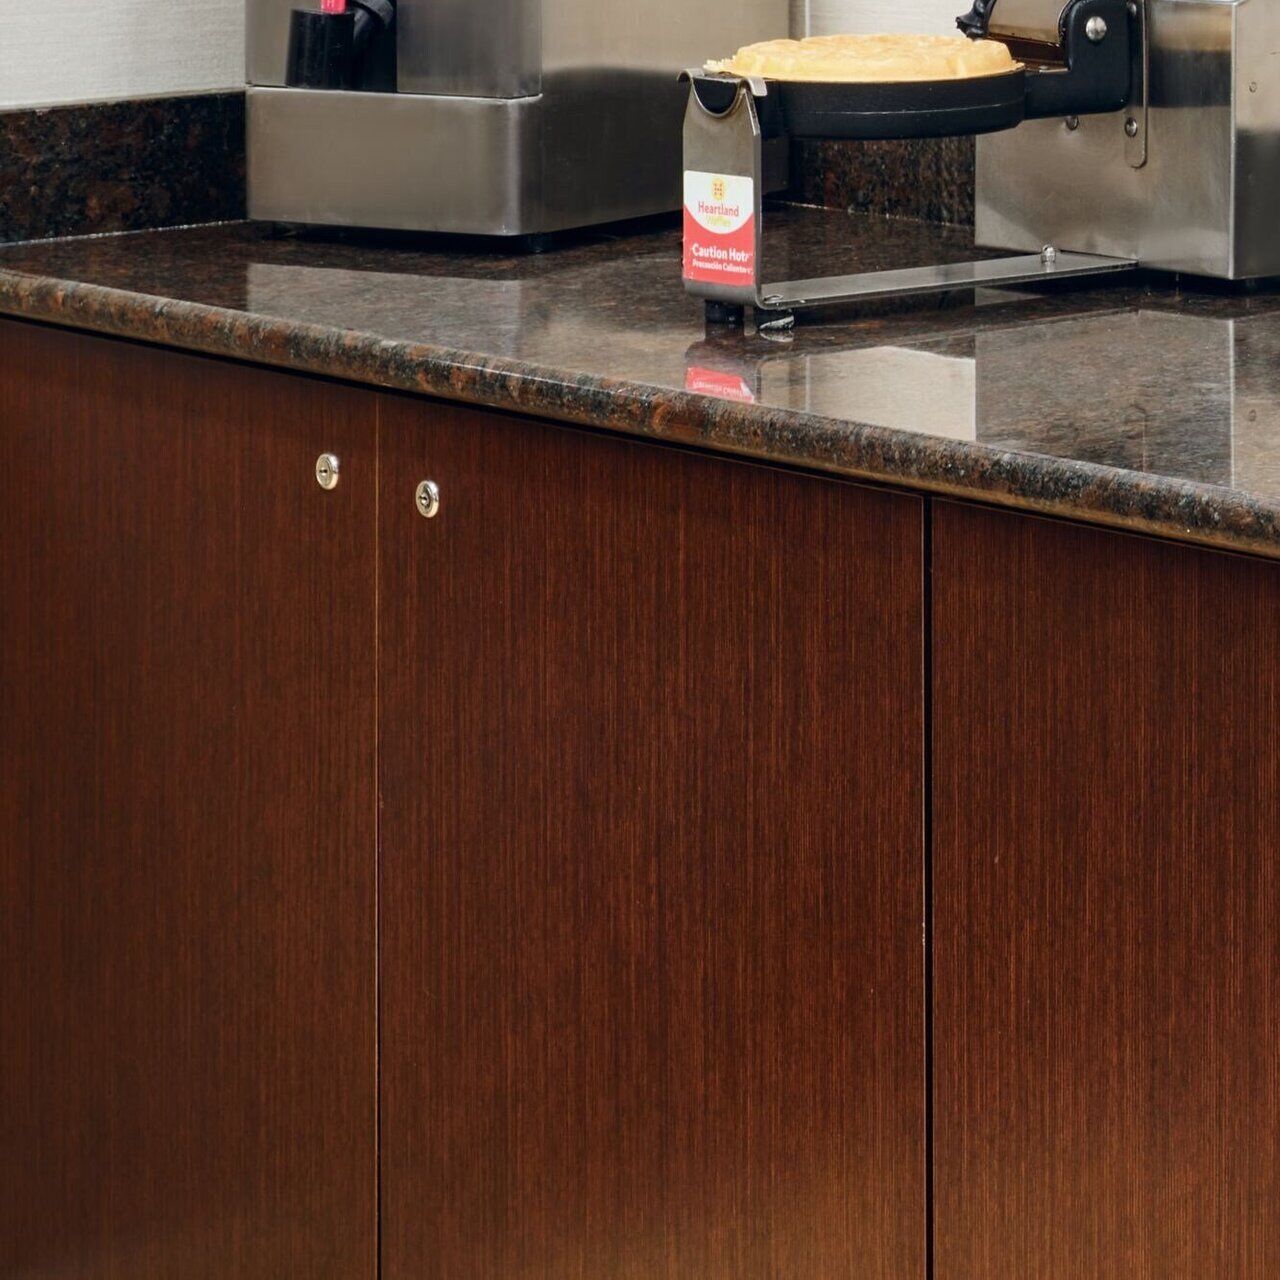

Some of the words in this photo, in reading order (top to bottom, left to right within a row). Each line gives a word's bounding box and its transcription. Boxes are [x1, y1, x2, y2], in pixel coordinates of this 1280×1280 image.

[698, 201, 739, 217] Heartland
[692, 243, 728, 259] Caution
[729, 247, 747, 262] Hot
